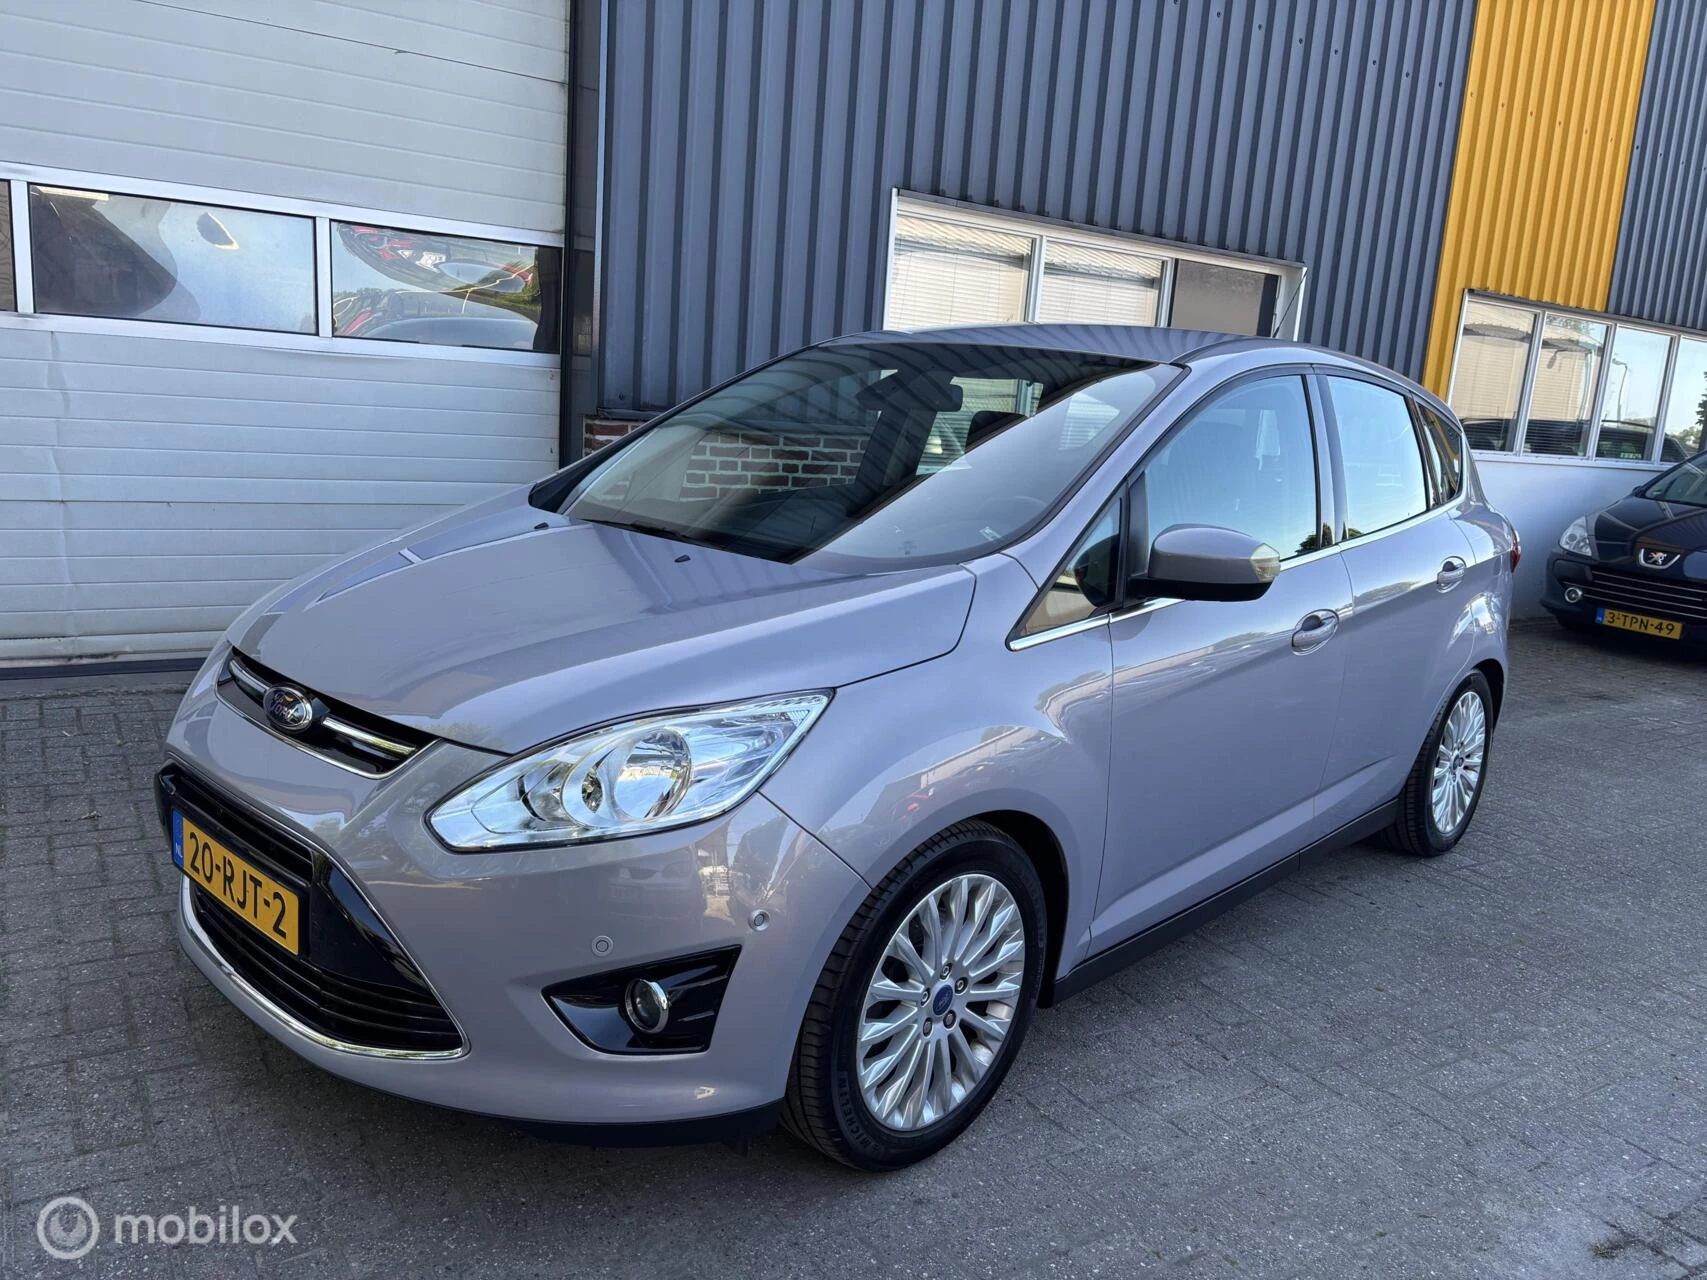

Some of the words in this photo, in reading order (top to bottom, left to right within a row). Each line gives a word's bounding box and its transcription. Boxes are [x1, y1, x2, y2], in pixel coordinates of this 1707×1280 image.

[1607, 611, 1675, 635] 3-TPN-49
[189, 831, 287, 939] 20-RJT-2
[838, 1077, 872, 1148] MICHELIN
